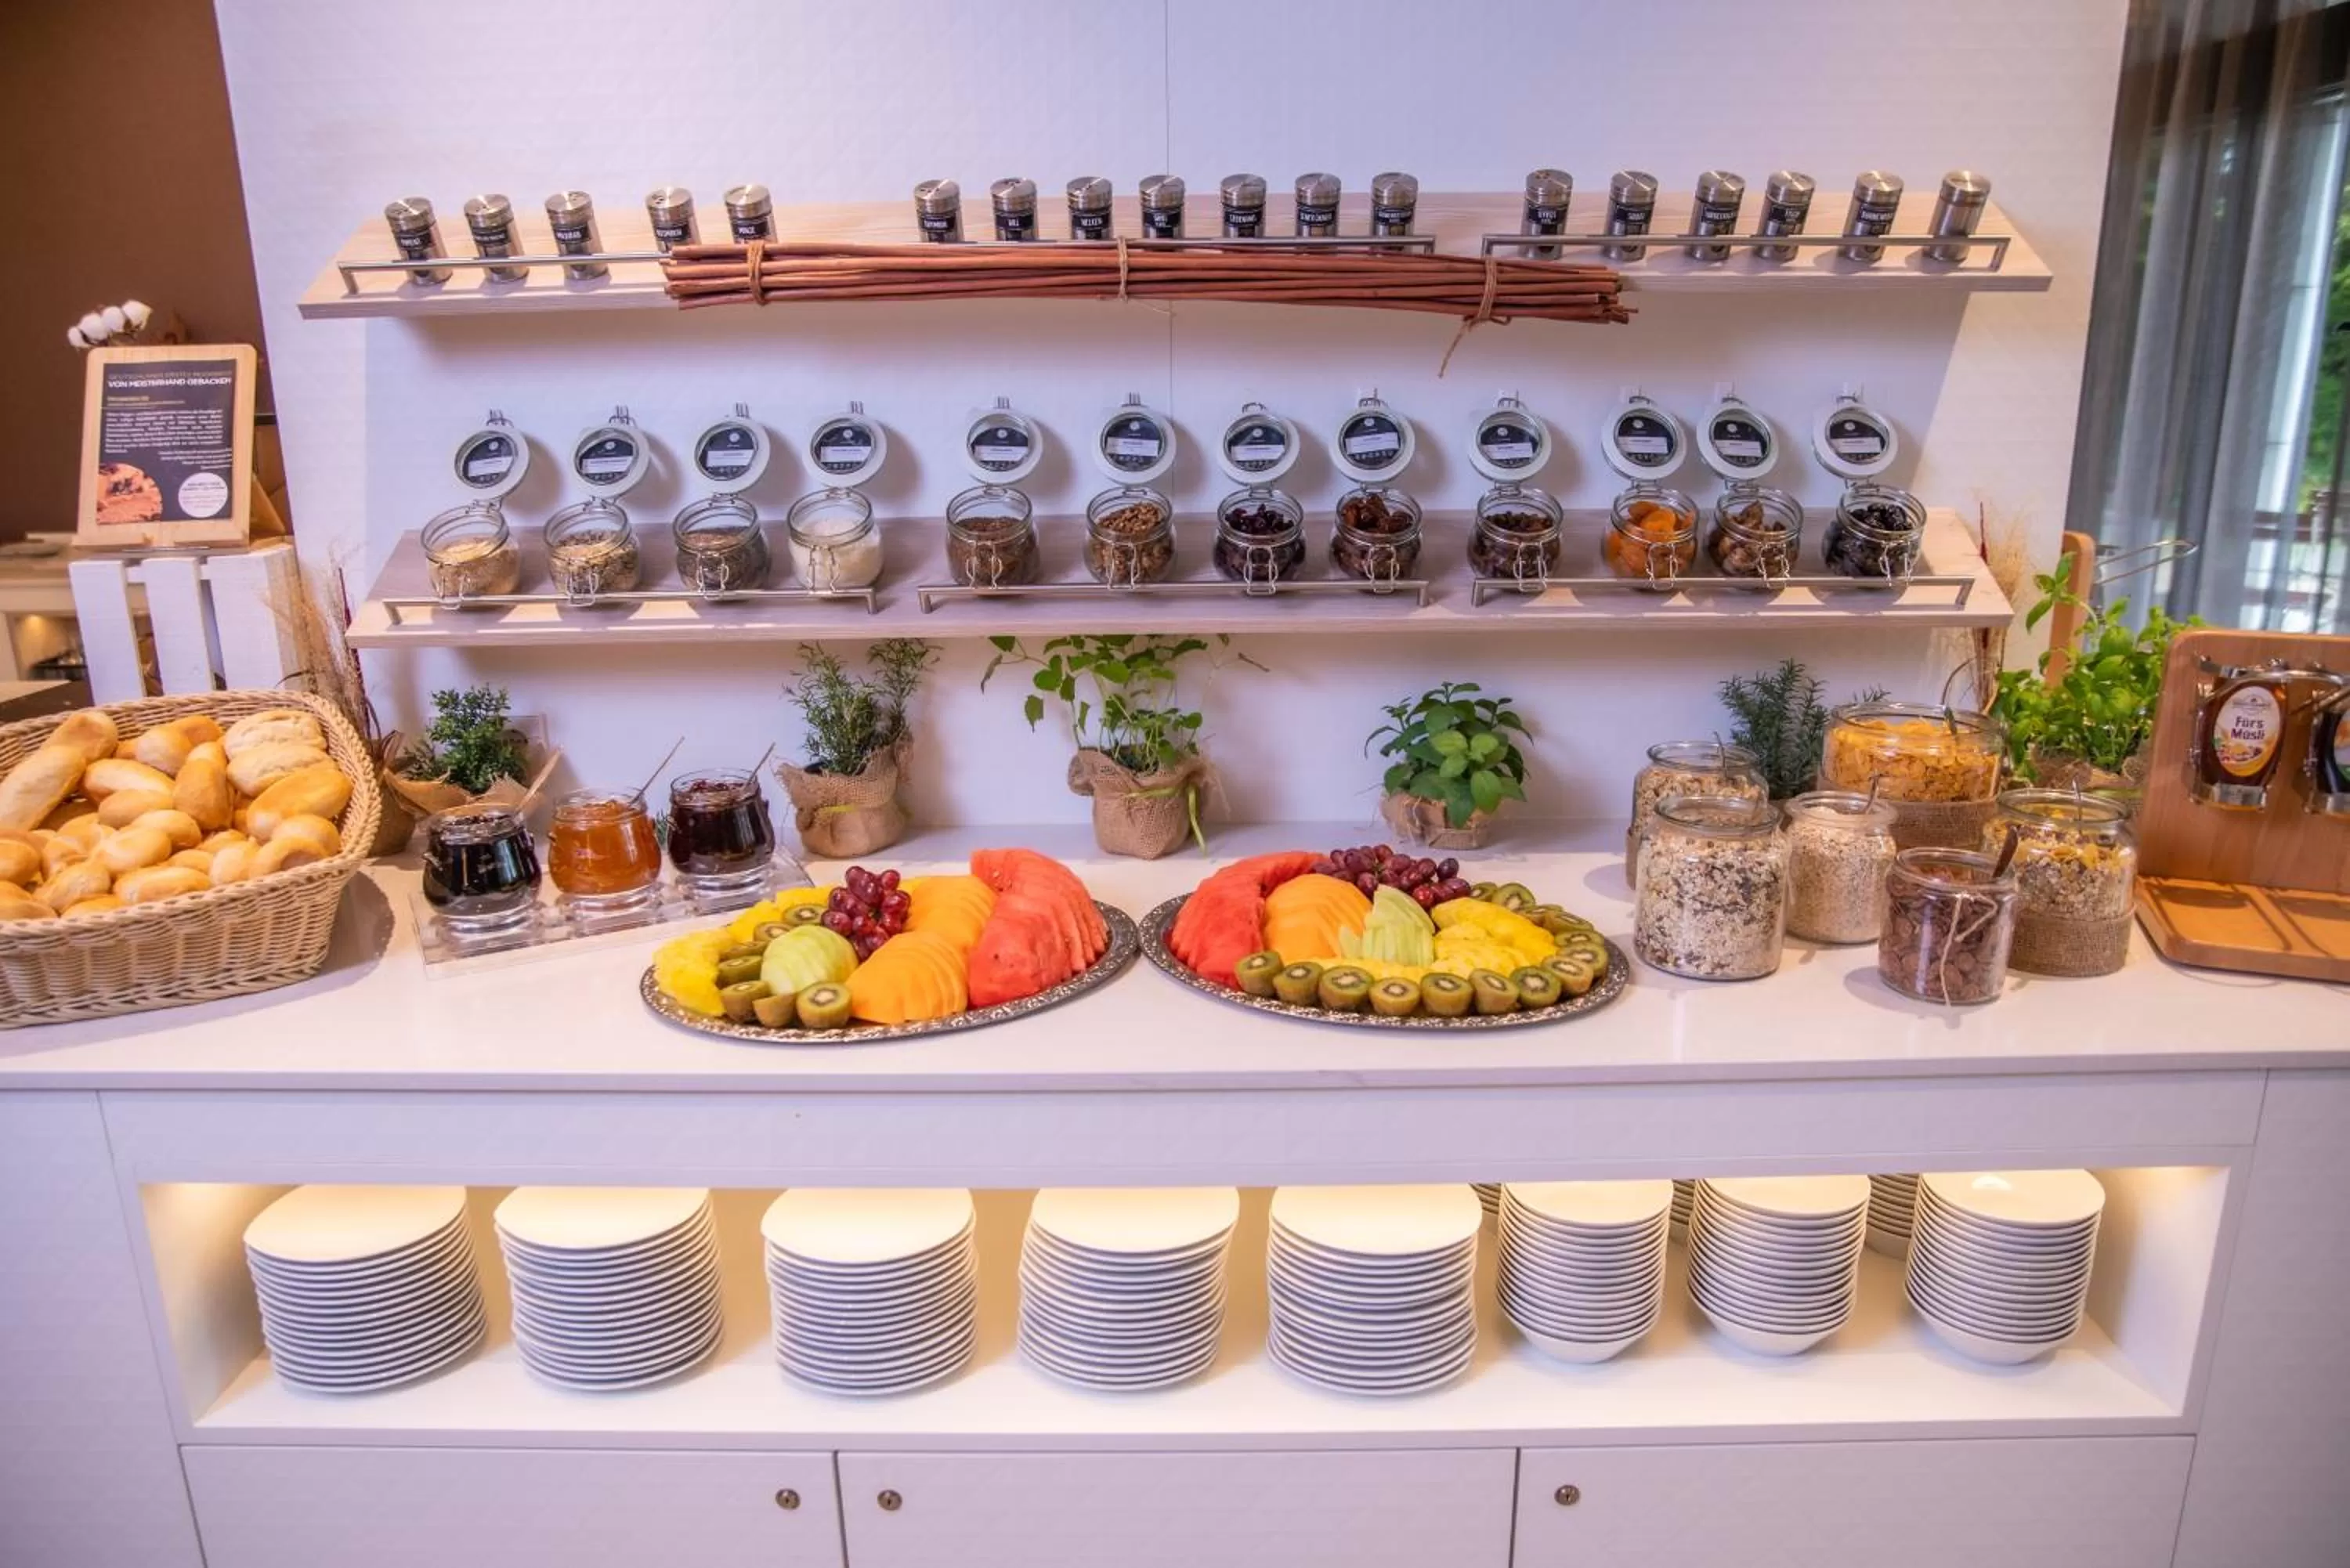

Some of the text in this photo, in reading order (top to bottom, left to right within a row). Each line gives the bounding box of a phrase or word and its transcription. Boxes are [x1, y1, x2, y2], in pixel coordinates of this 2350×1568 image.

[128, 378, 185, 388] MEISTERHAND
[187, 377, 233, 386] GEBACKEN
[2235, 715, 2265, 728] Fürs
[2231, 728, 2265, 740] Müsli
